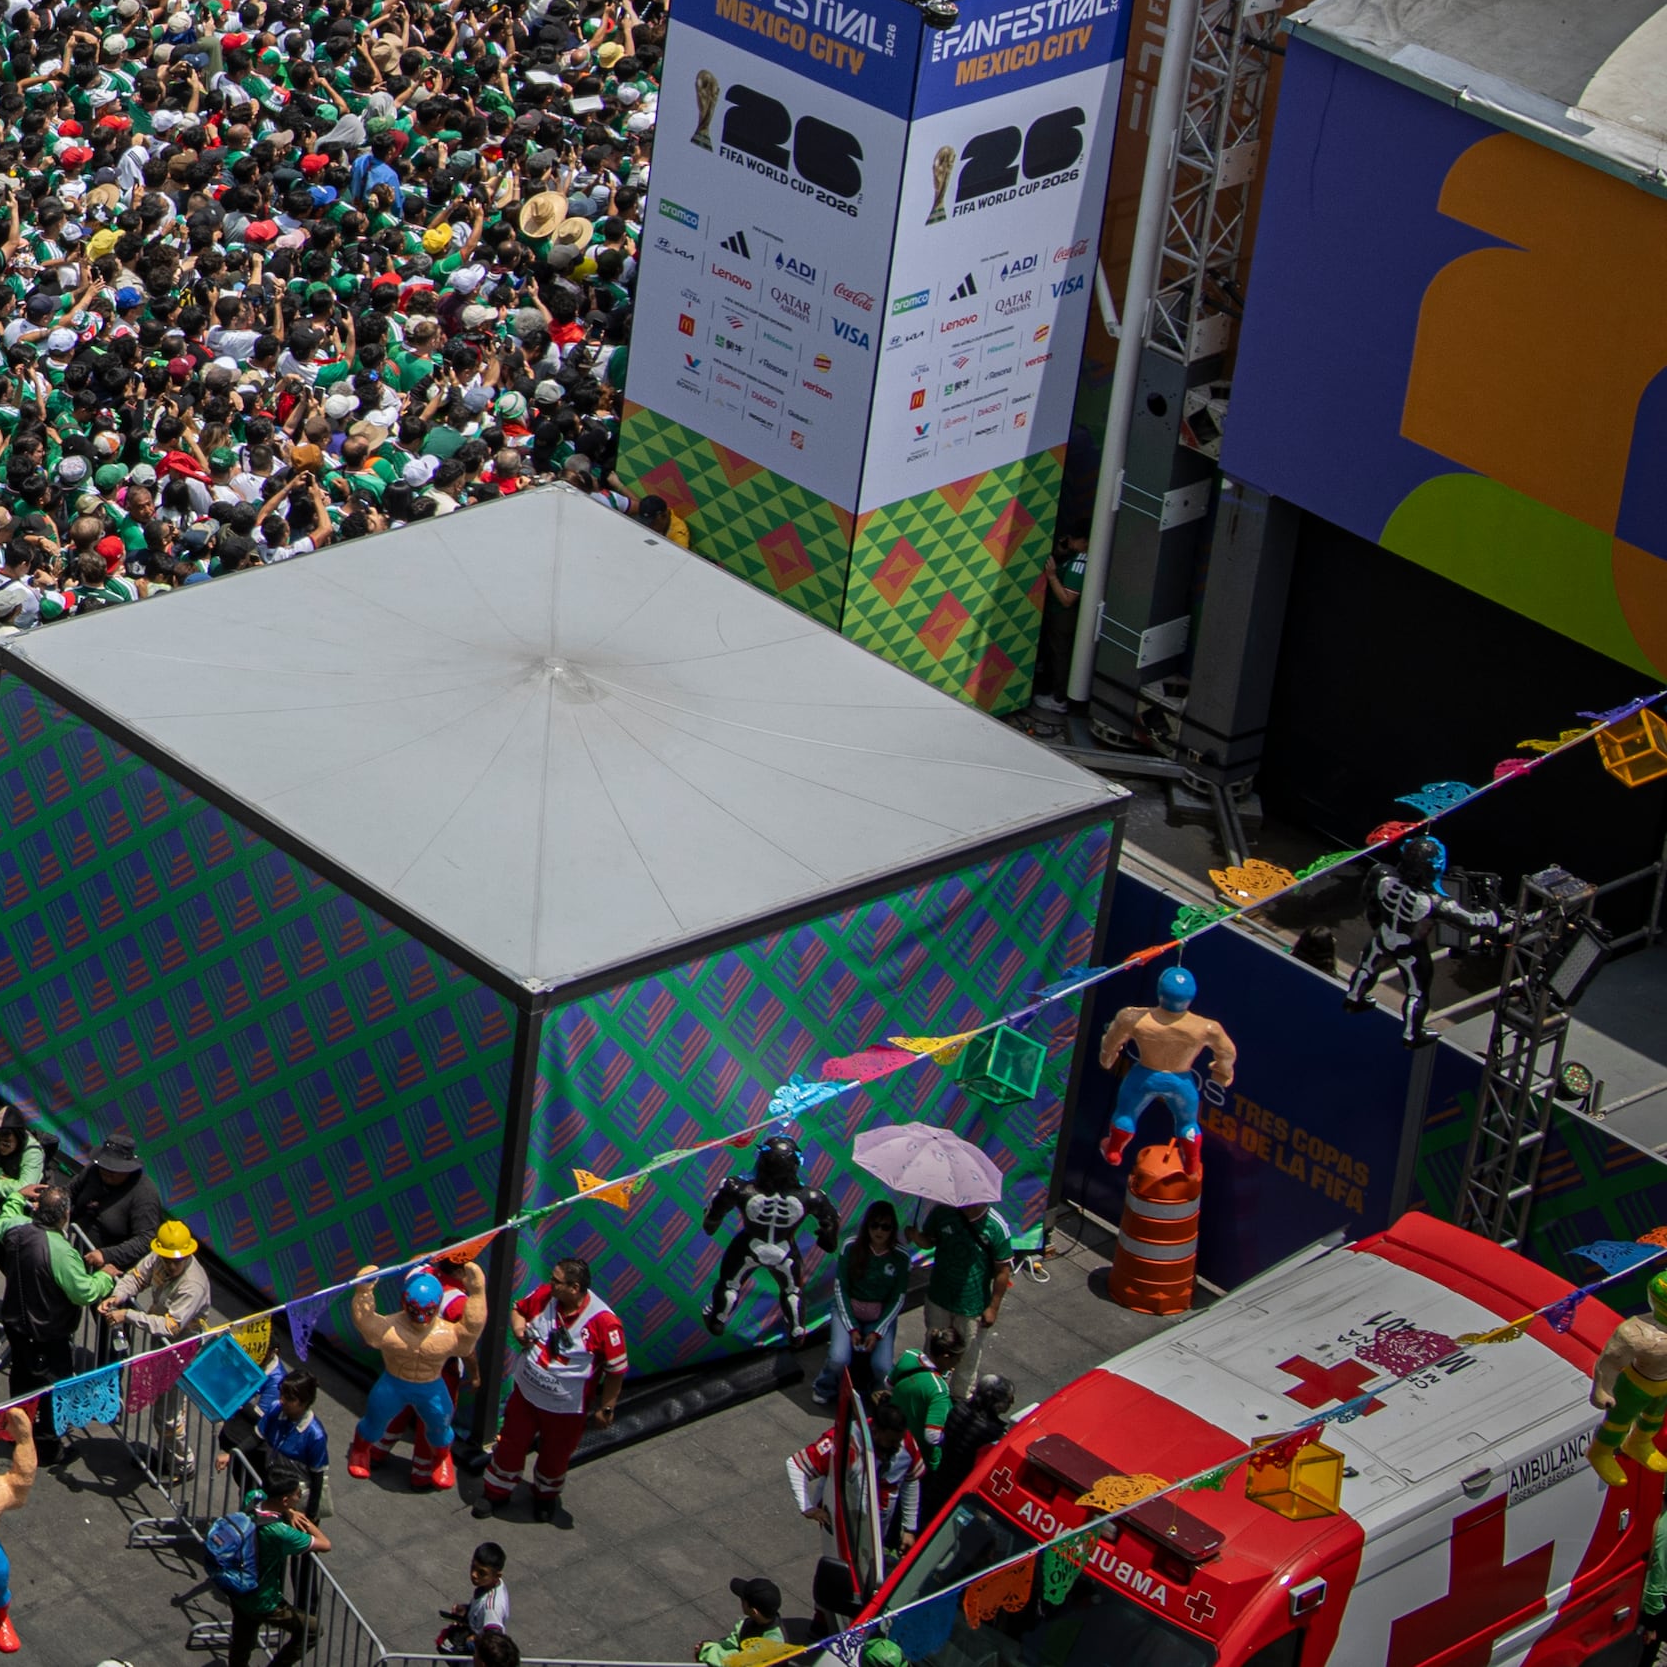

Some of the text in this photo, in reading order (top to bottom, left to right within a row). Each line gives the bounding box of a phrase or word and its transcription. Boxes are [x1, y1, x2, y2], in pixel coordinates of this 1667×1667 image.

[810, 33, 865, 75] CITY
[884, 23, 897, 57] 2026
[931, 29, 945, 63] FIFA
[955, 24, 1093, 86] MEXICO CITY
[721, 84, 863, 198] 26
[955, 106, 1086, 203] 26
[719, 145, 859, 218] FIFA WORLD CUP 2026
[952, 168, 1080, 218] FIFA WORLD CUP 2026
[660, 202, 699, 228] aramco
[712, 263, 752, 291] Lenovo
[785, 258, 816, 282] ADI
[1010, 253, 1038, 275] ADI
[893, 292, 930, 311] aramco
[995, 290, 1032, 313] QATAR
[1051, 274, 1084, 299] VISA
[1003, 302, 1031, 317] AIRWAYS
[770, 287, 811, 316] QATAR
[831, 316, 870, 351] VISA
[779, 304, 811, 324] AIRWAYS
[940, 313, 978, 333] Lenovo
[1024, 352, 1053, 369] verizon
[750, 390, 778, 410] DIAGEO
[801, 379, 834, 401] verizon
[1233, 1093, 1369, 1187] TRES COPAS
[1240, 1125, 1272, 1162] DE
[1275, 1145, 1306, 1182] LA
[1310, 1165, 1364, 1214] FIFA
[1509, 1433, 1592, 1494] AMBULANCI
